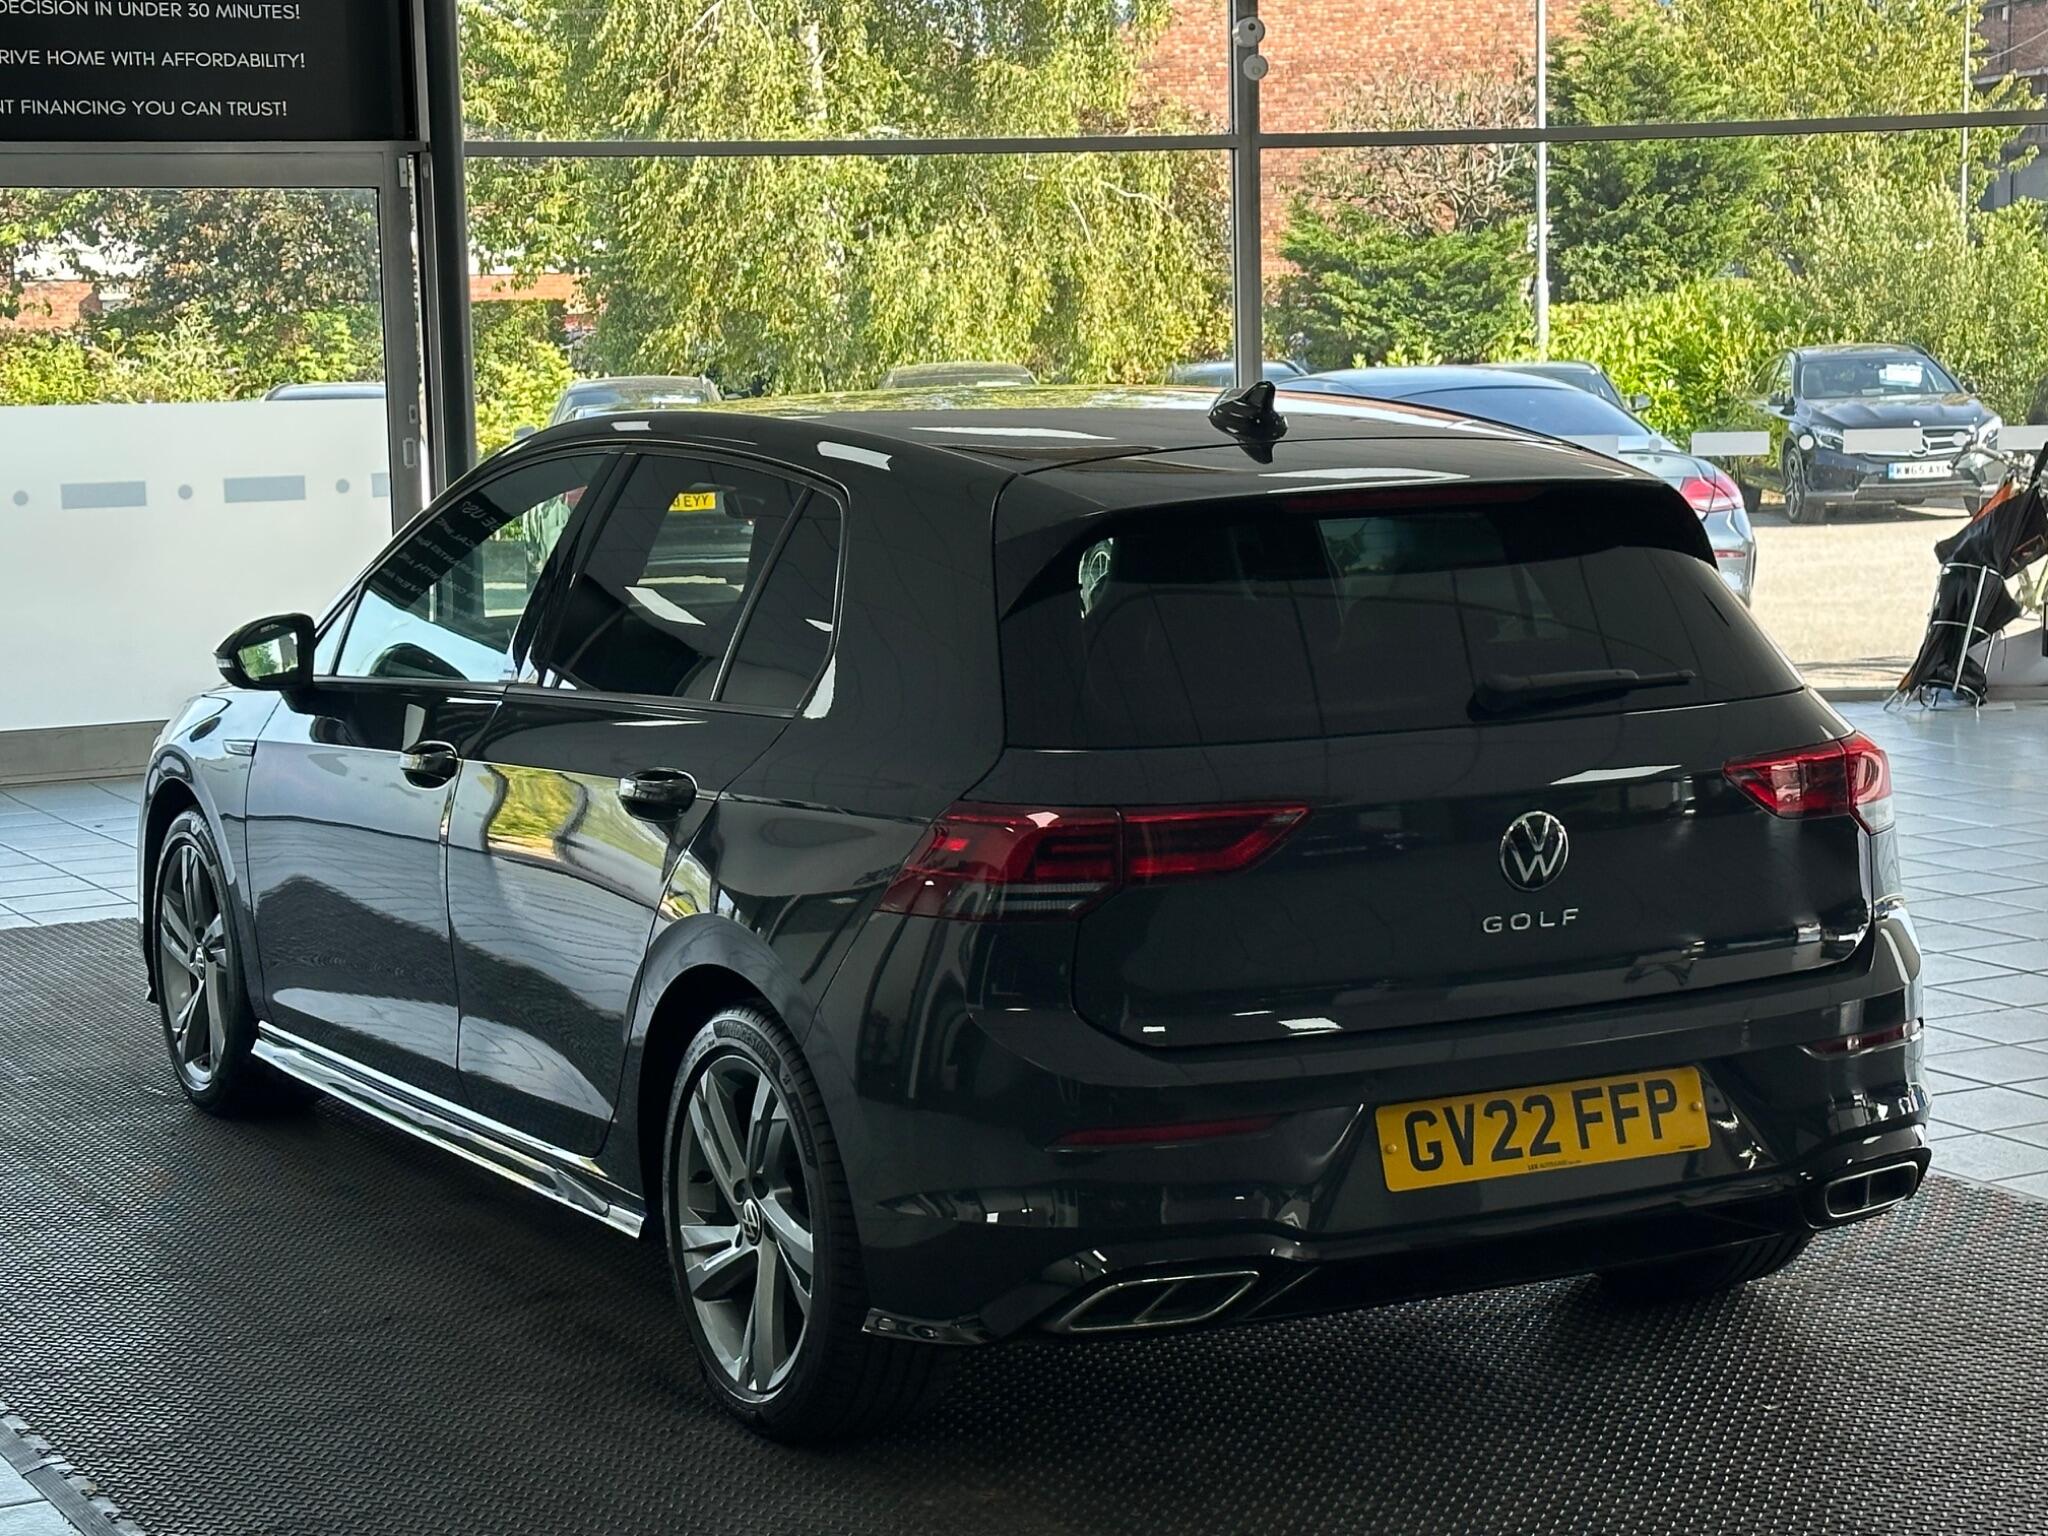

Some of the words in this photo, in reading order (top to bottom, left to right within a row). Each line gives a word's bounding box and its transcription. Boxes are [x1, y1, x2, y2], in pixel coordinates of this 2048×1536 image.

[0, 0, 89, 15] DECISION
[94, 1, 113, 16] IN
[118, 2, 182, 18] UNDER
[187, 3, 210, 18] 30
[215, 3, 301, 20] MINUTES!
[47, 50, 106, 66] HOME
[110, 51, 155, 67] WITH
[161, 51, 306, 69] AFFORDABILITY!
[0, 99, 15, 115] T
[20, 99, 127, 115] FINANCING
[131, 100, 175, 116] YOU
[180, 100, 222, 116] CAN
[226, 101, 287, 117] TRUST!
[683, 495, 709, 507] EYY
[1482, 908, 1579, 933] GOLF
[1404, 1094, 1562, 1172] GV22
[1570, 1078, 1678, 1150] FFP
